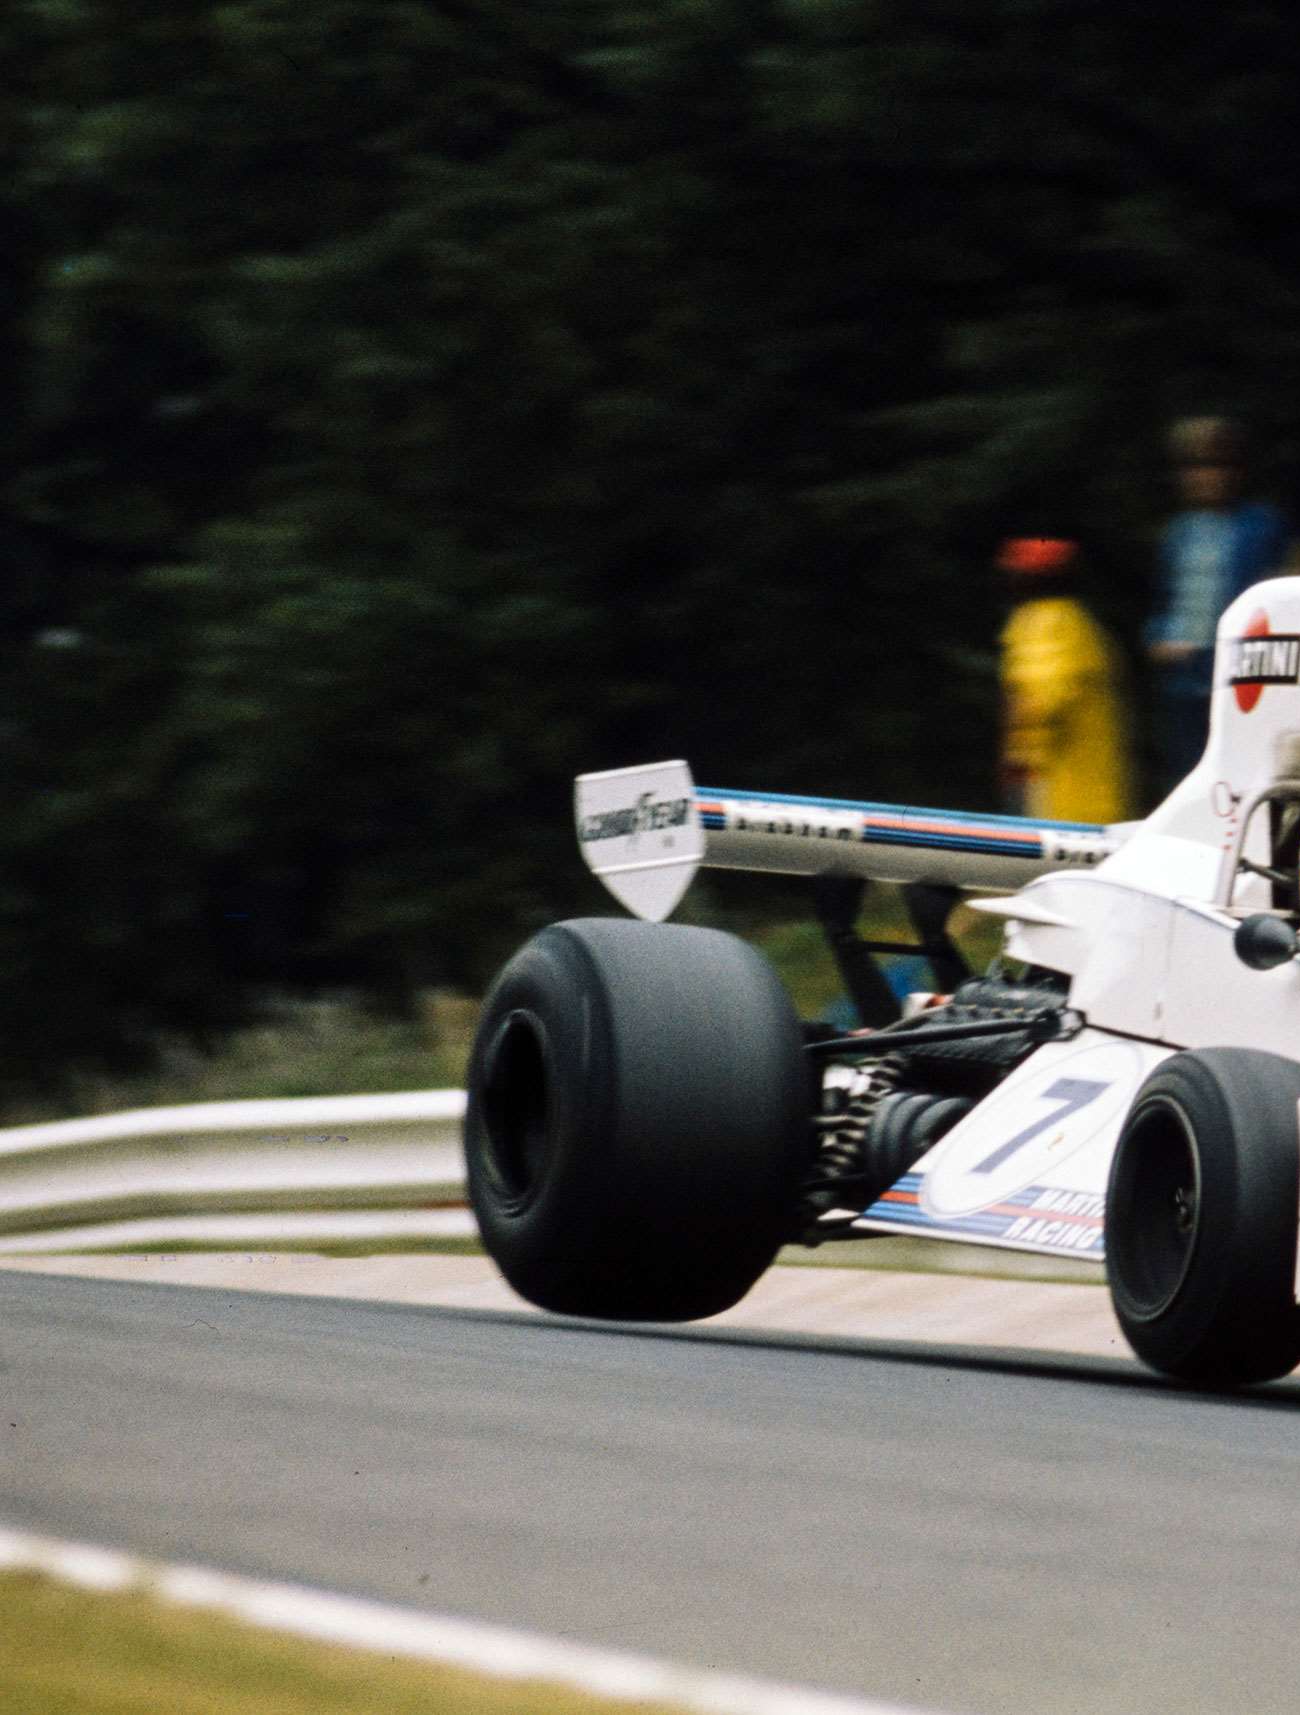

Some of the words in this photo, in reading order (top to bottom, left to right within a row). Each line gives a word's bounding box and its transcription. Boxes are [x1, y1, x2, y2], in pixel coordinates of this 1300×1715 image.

[971, 1078, 1111, 1174] 7
[1031, 1189, 1105, 1217] MARTI
[1002, 1215, 1104, 1249] RACING
